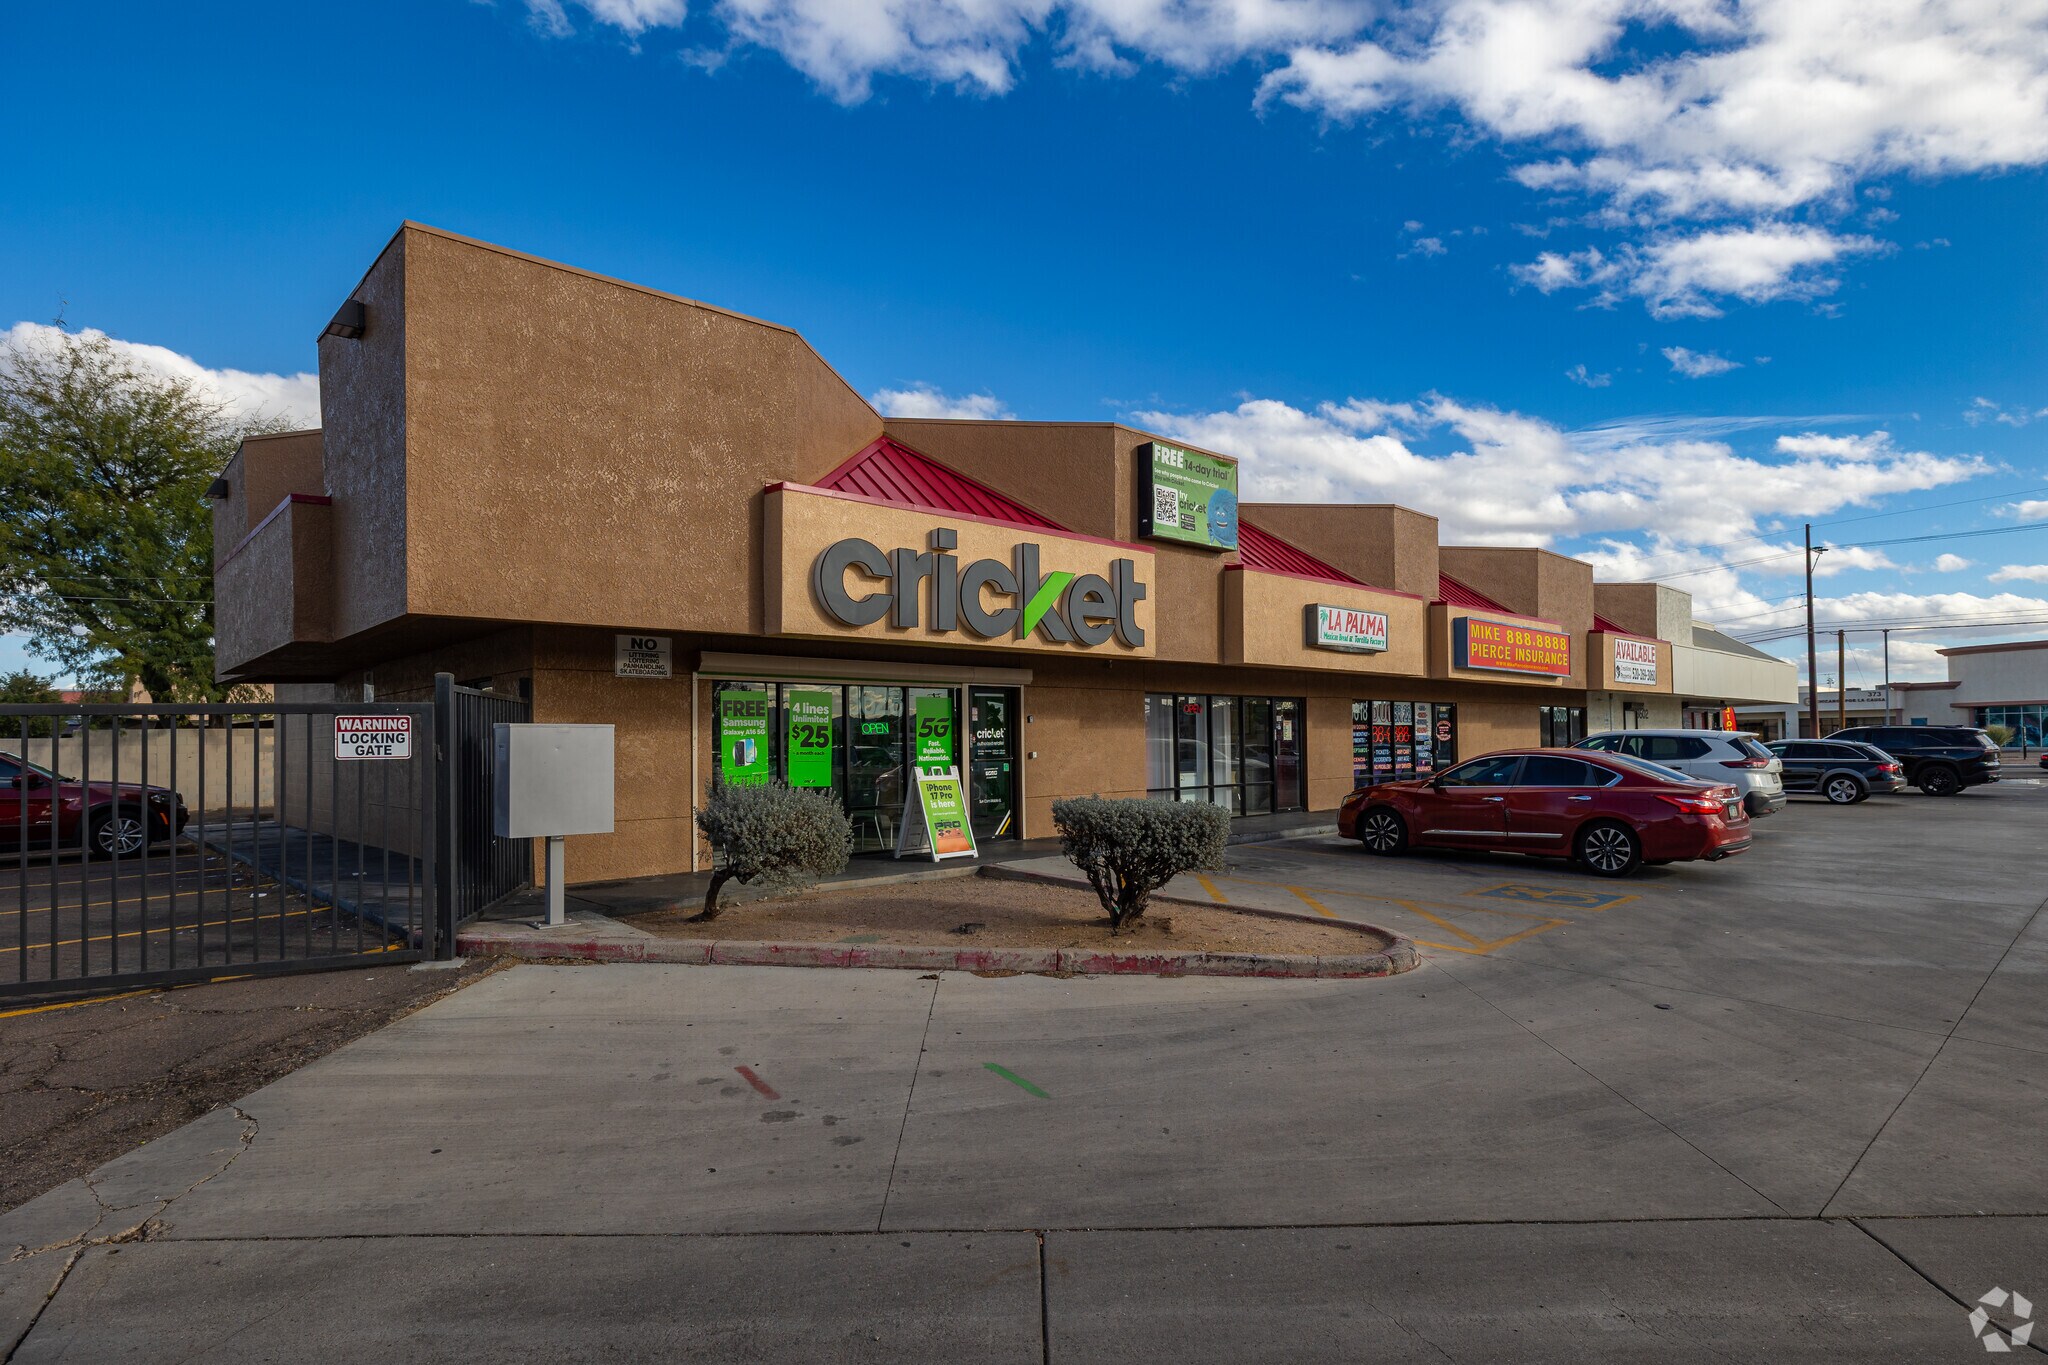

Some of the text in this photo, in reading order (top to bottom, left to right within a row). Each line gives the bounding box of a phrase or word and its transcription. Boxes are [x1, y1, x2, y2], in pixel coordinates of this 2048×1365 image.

[1154, 444, 1184, 468] FREE
[1184, 459, 1212, 478] 14-day
[1179, 490, 1188, 500] try
[1180, 500, 1206, 514] cricket
[813, 527, 1146, 647] cricket
[1329, 610, 1384, 636] LA PALMA
[630, 637, 658, 650] NO
[1324, 632, 1338, 640] Mexican
[1370, 637, 1385, 647] Factory
[1471, 624, 1567, 651] MIKE 888.8888
[1471, 642, 1568, 666] PIERCE INSURANCE
[1616, 641, 1656, 664] AVAILABLE
[619, 668, 668, 676] SKATEBOARDING
[622, 662, 666, 670] PANHANDLING
[723, 700, 766, 717] FREE
[792, 703, 829, 715] 4 lines
[339, 719, 408, 731] WARNING
[723, 718, 766, 729] Samsung
[793, 715, 829, 723] Unlimited
[862, 723, 889, 735] OPEN
[918, 717, 950, 738] 5G
[976, 728, 1005, 739] cricket
[341, 733, 406, 744] LOCKING
[792, 724, 829, 748] $25
[355, 745, 392, 756] GATE
[930, 791, 953, 800] 17 Pro
[938, 800, 955, 808] here
